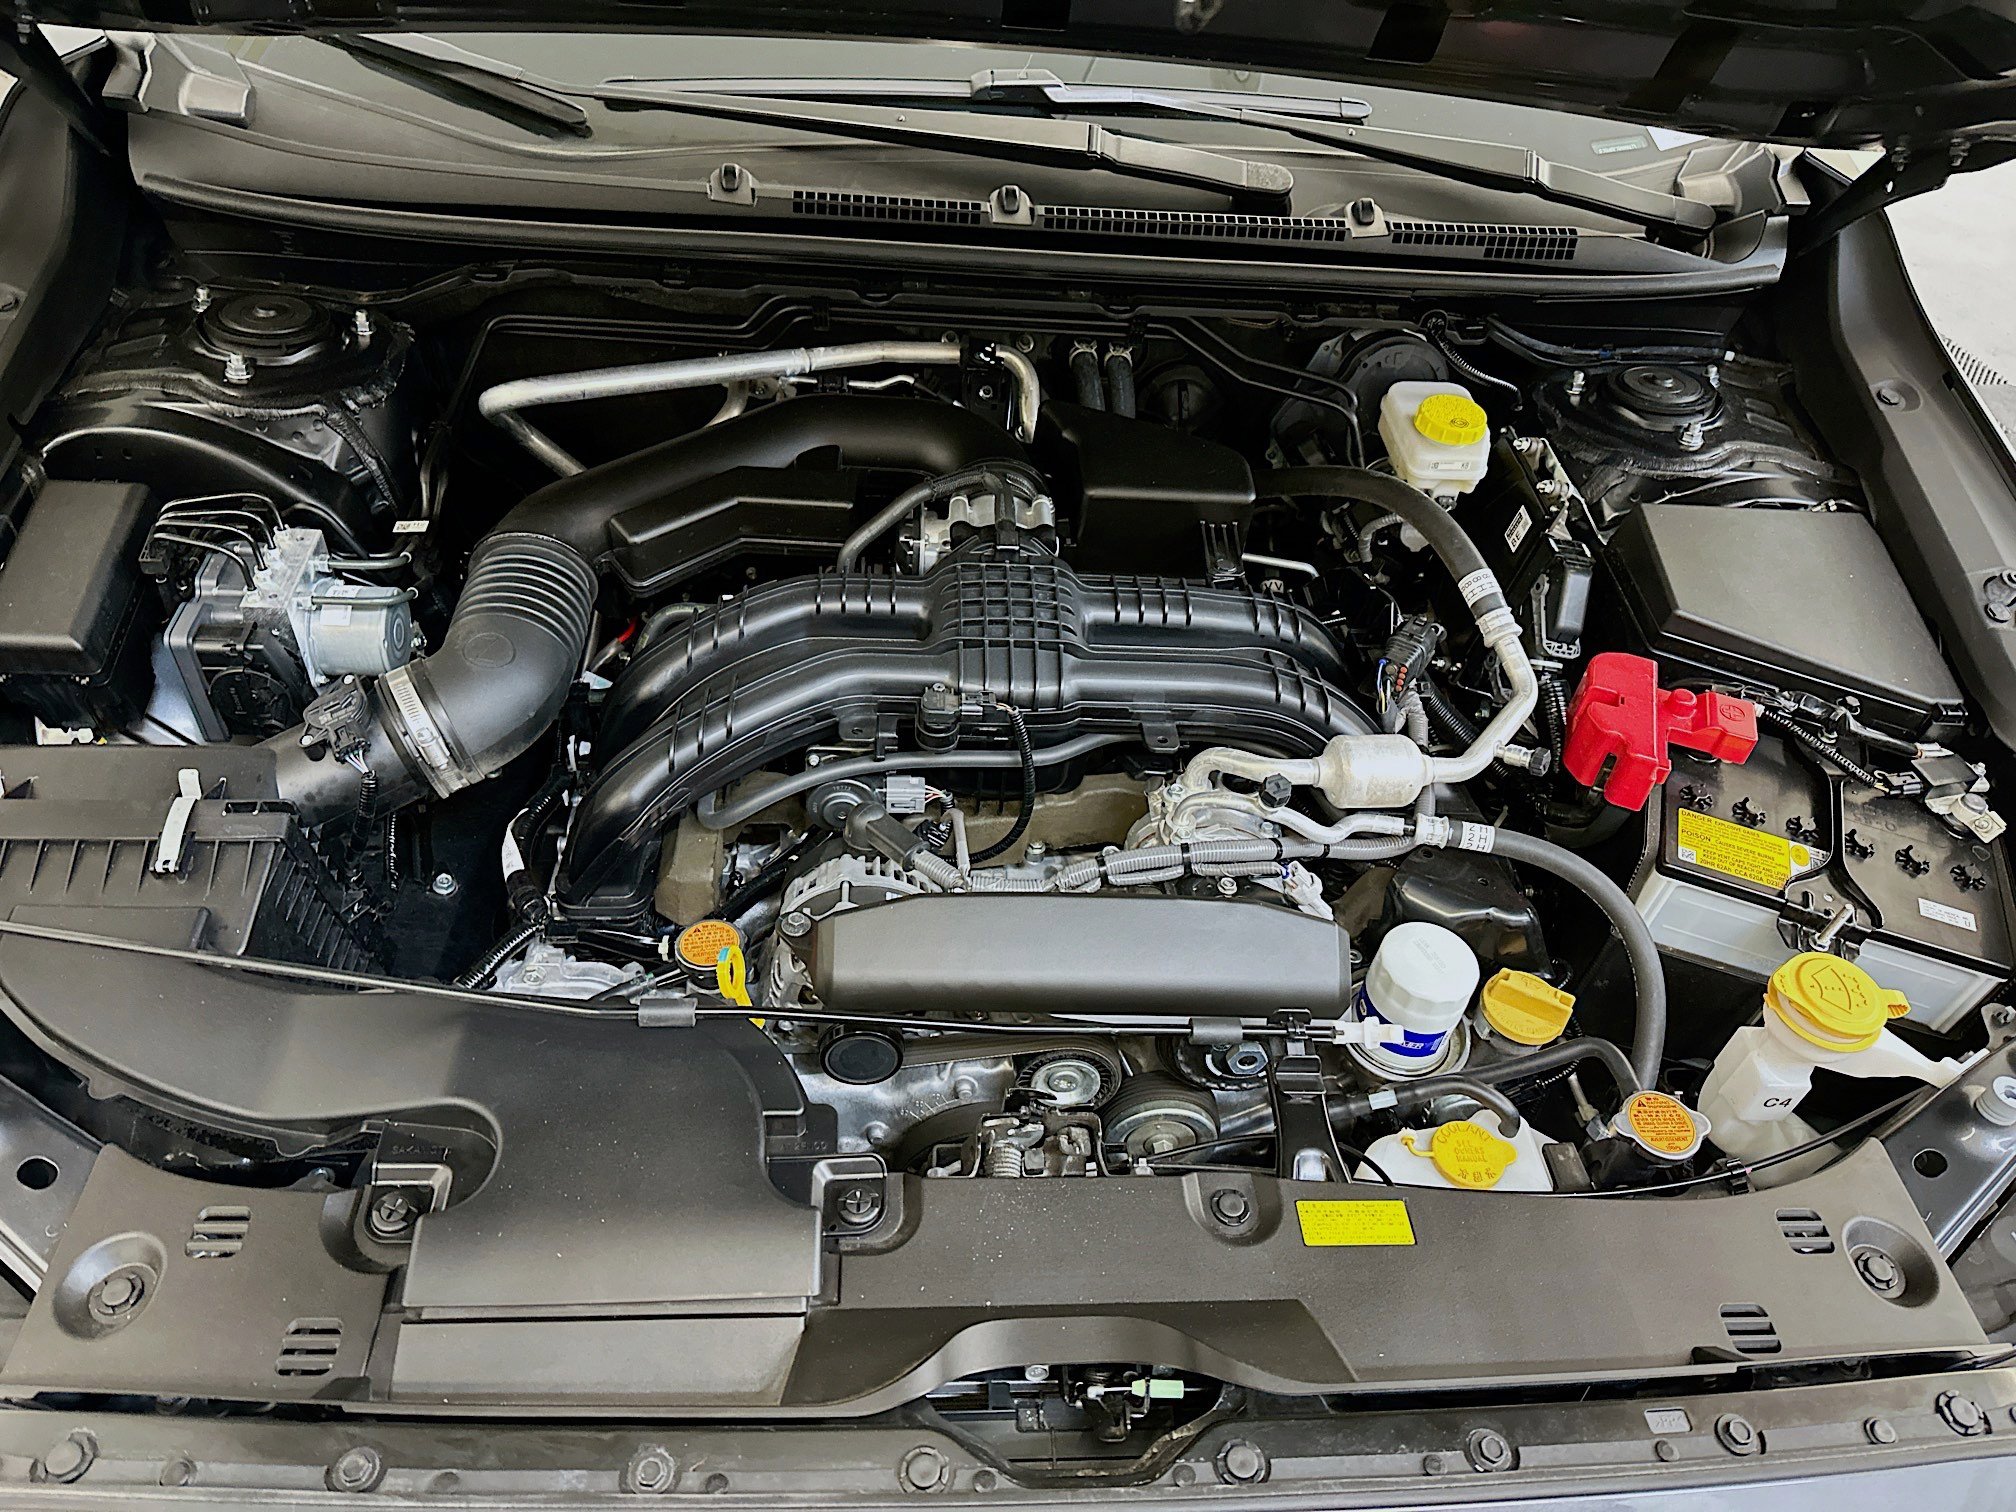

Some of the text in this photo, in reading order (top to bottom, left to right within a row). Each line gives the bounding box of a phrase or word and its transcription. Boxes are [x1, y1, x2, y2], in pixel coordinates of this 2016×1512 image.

[1681, 810, 1712, 823] DANGER
[1681, 828, 1775, 861] POISON CAUSES SEVERE BURNS
[1703, 853, 1717, 861] KEEP
[1736, 863, 1755, 873] REACH
[1716, 862, 1732, 872] 62Ah
[1734, 868, 1748, 877] CCA
[1731, 857, 1745, 865] CAPS
[1746, 861, 1761, 869] TIGHT
[1762, 866, 1773, 874] AND
[1763, 1097, 1793, 1108] C4
[1436, 1122, 1494, 1144] COOLANT
